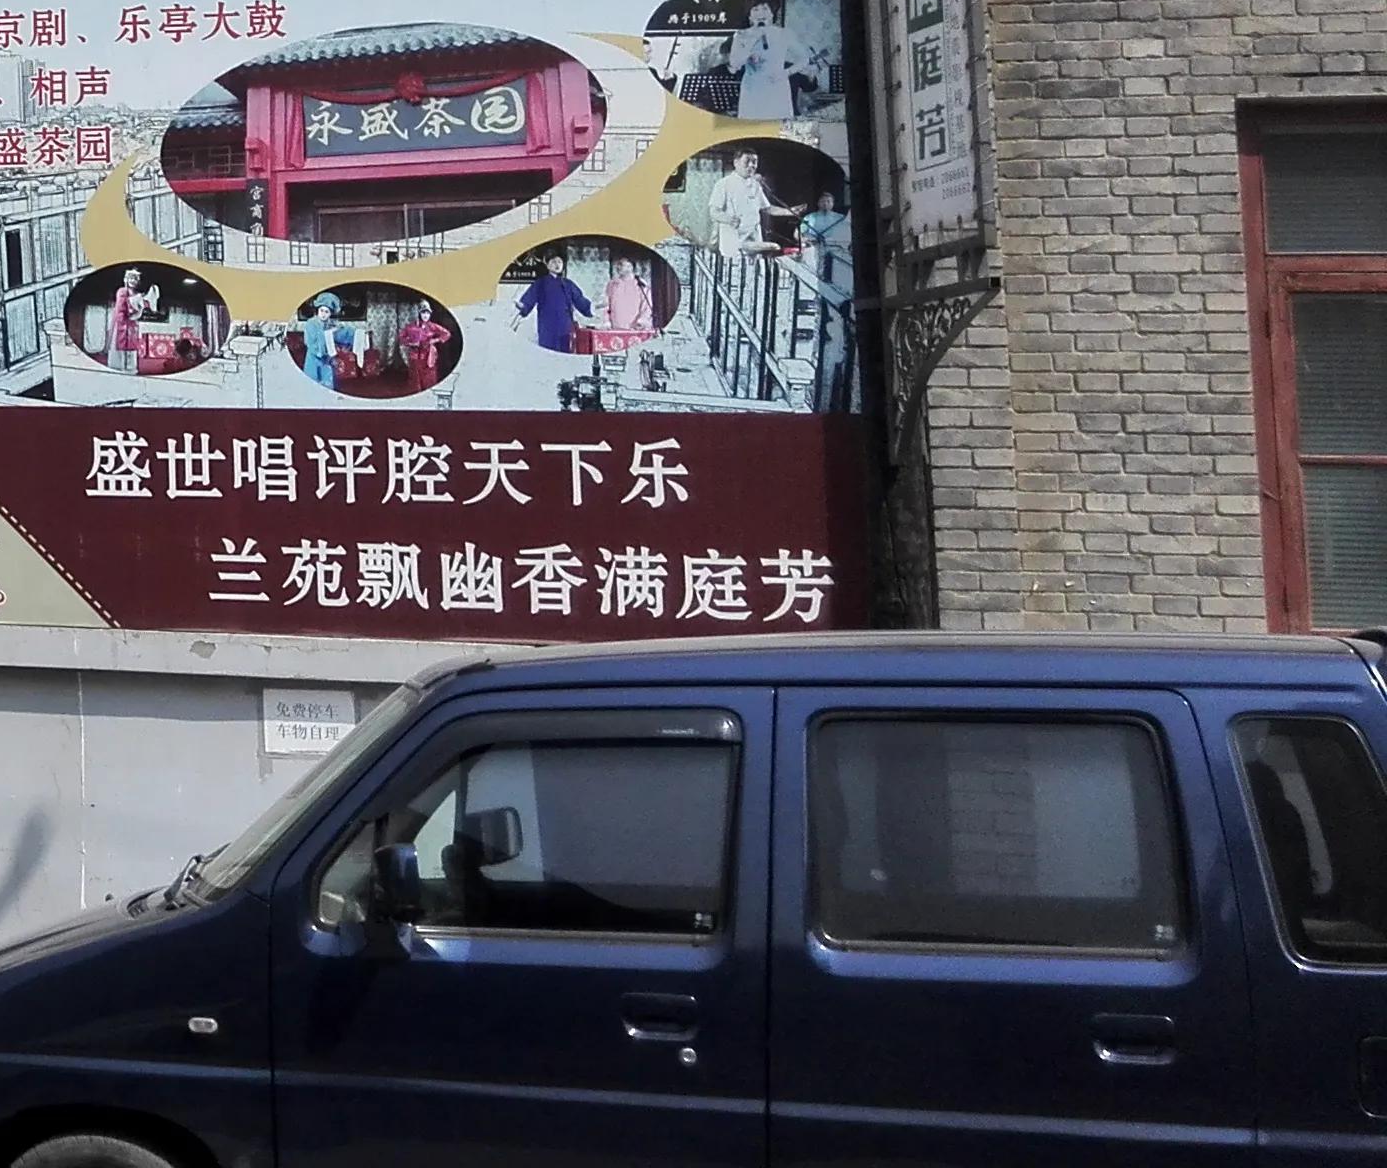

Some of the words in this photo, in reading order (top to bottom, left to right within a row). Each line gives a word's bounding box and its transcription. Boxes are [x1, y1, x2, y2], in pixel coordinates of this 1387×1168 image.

[306, 85, 526, 146] 永盛茶园
[85, 432, 690, 506] 盛世唱评腔天下乐
[208, 538, 835, 623] 兰苑飘幽香满庭芳
[276, 700, 340, 720] 免费停车
[276, 723, 340, 742] 车物自理
